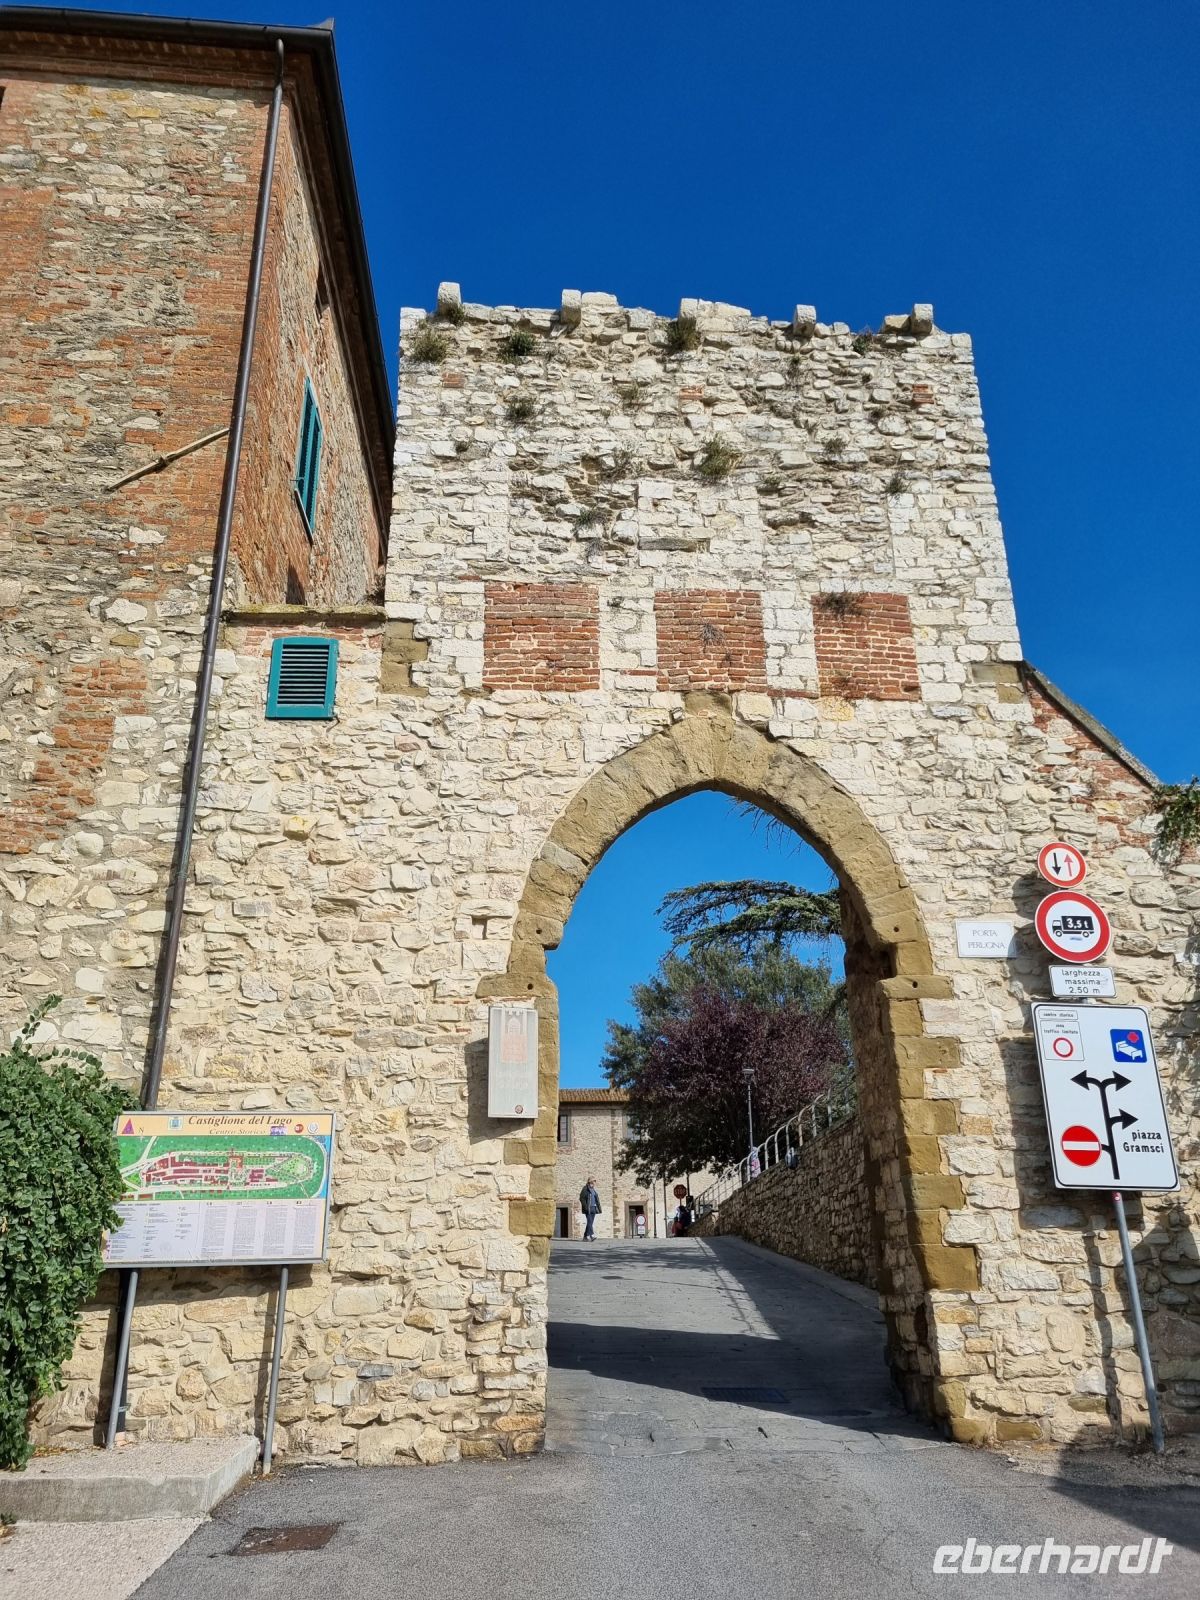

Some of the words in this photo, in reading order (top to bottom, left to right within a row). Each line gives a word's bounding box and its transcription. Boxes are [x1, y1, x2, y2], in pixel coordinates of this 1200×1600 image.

[1067, 918, 1082, 929] 3,5
[1062, 969, 1100, 977] larghezza
[188, 1116, 246, 1126] Castiglione
[248, 1116, 263, 1125] del
[266, 1116, 292, 1127] Lago
[1132, 1130, 1162, 1142] piazza
[1123, 1142, 1164, 1153] Gramsci
